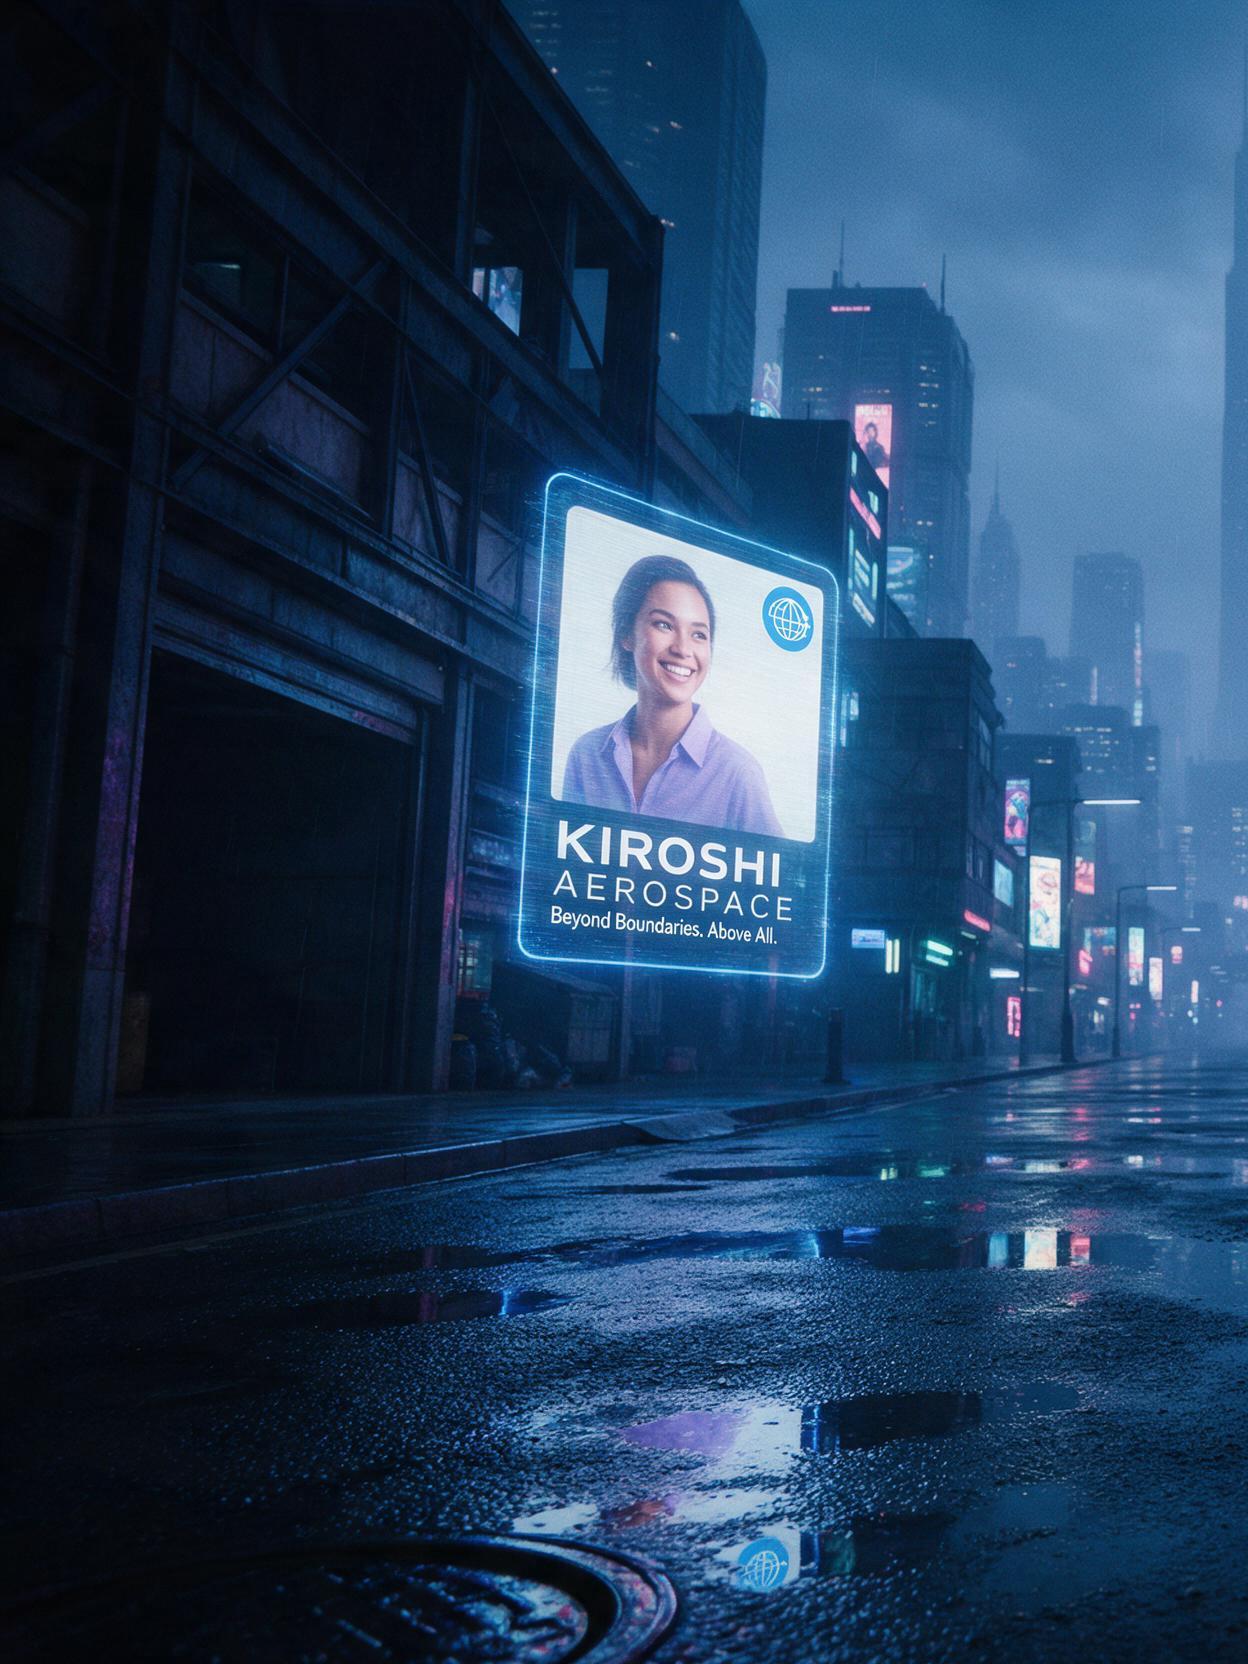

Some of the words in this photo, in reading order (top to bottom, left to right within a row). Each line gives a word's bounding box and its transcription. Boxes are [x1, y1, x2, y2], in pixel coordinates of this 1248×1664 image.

[557, 819, 781, 888] KIROSHI
[553, 870, 793, 921] AEROSPACE
[550, 905, 611, 929] Beyond
[615, 913, 704, 938] Boundaries.
[707, 921, 751, 942] Above
[754, 926, 778, 945] All.
